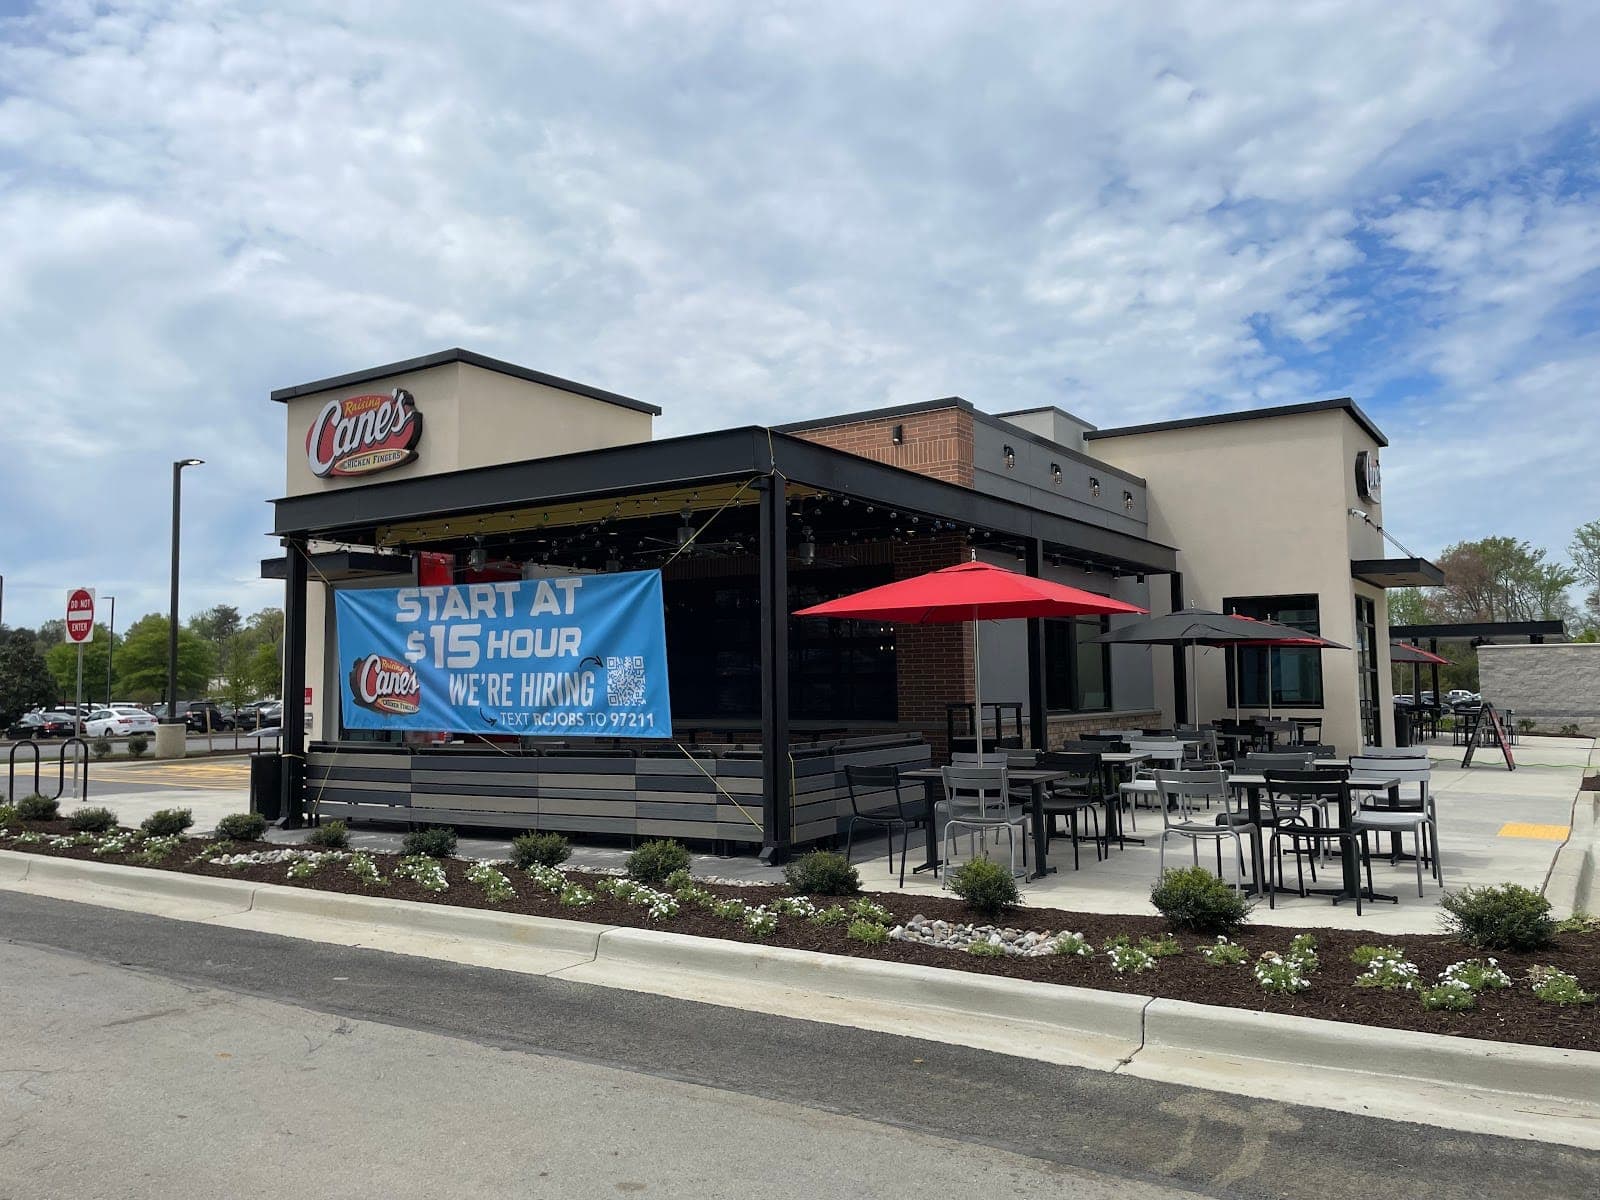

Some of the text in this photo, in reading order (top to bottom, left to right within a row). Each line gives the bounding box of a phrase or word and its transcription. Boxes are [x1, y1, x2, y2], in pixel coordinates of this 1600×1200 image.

[344, 397, 380, 416] Raising
[308, 388, 413, 475] Cane's
[343, 451, 401, 470] CHICKEN FINGERS
[71, 599, 91, 609] DO NOT
[396, 578, 583, 623] START AT
[72, 622, 88, 632] ENTER
[404, 623, 582, 669] $15 HOUR
[360, 654, 420, 703] Cane's
[449, 671, 595, 707] WE'RE HIRING
[500, 712, 654, 727] TEXT RCJOBS TO 97211
